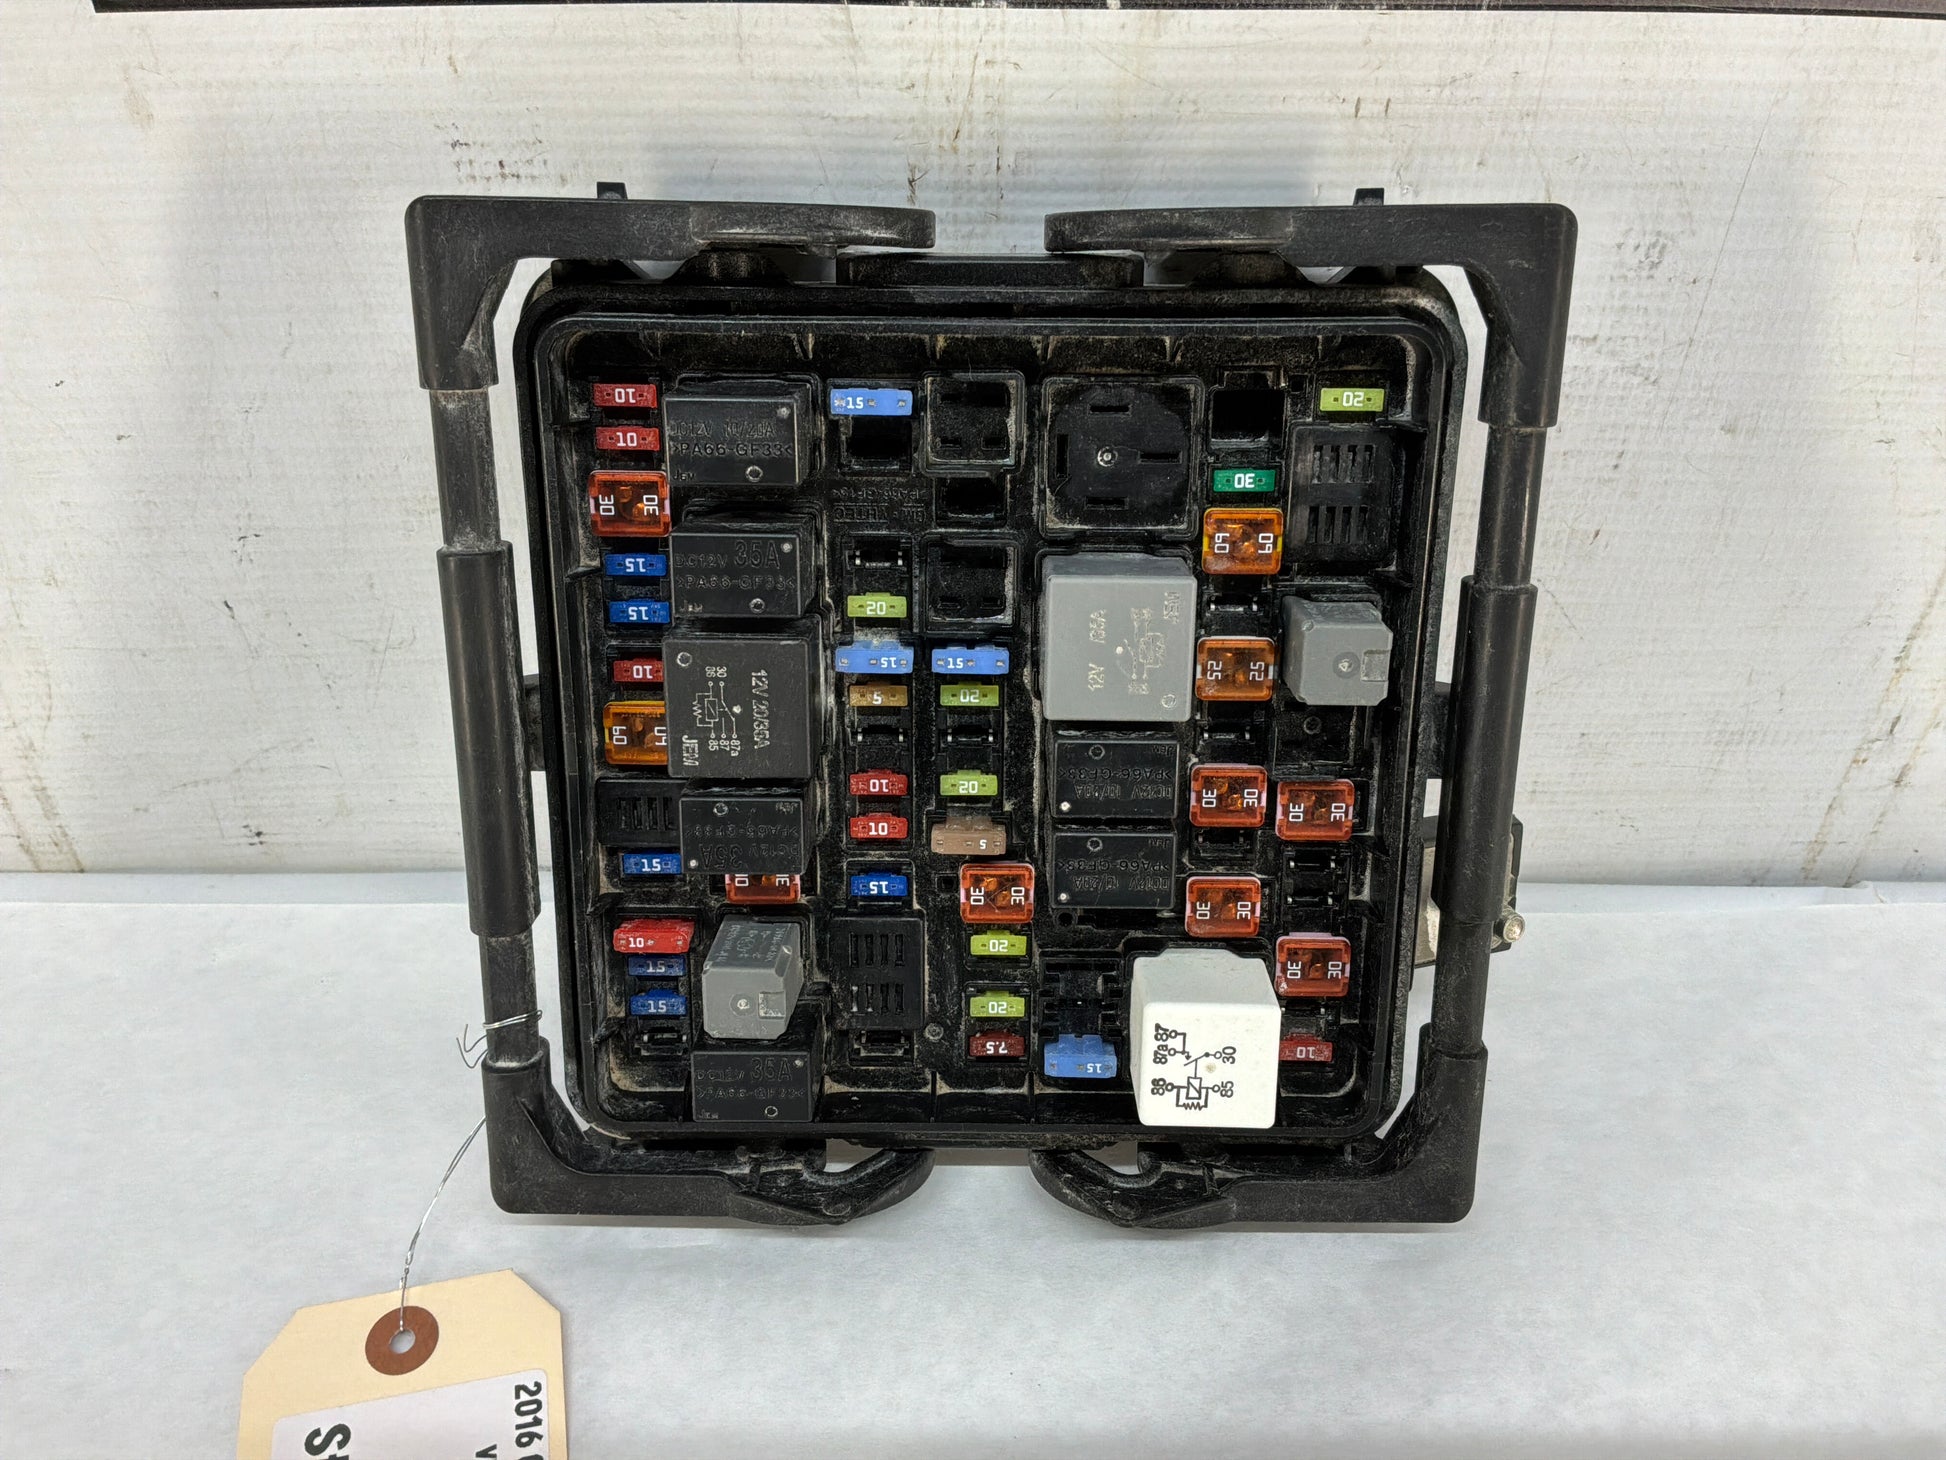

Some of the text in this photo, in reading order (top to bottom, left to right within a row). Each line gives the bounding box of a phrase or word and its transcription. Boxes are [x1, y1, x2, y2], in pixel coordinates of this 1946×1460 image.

[614, 388, 636, 403] 10
[846, 397, 864, 409] 15
[1342, 392, 1364, 406] 20
[617, 432, 637, 447] 10
[1234, 473, 1255, 488] 30
[598, 494, 615, 516] 30
[642, 494, 659, 516] 30
[1214, 532, 1229, 554] 60
[1258, 532, 1273, 554] 60
[734, 540, 780, 569] 35A
[625, 558, 647, 572] 15
[629, 606, 648, 620] 15
[866, 602, 886, 615] 20
[880, 657, 897, 668] 15
[947, 658, 963, 668] 15
[1207, 660, 1223, 680] 25
[1249, 661, 1265, 681] 25
[633, 665, 652, 679] 10
[873, 692, 882, 704] 5
[959, 690, 979, 702] 20
[751, 669, 771, 750] 12V 20/35A
[612, 726, 627, 745] 60
[681, 734, 699, 766] JEM
[870, 779, 888, 792] 10
[959, 781, 978, 794] 20
[1202, 788, 1217, 807] 30
[1243, 788, 1258, 807] 30
[1289, 803, 1303, 822] 30
[1331, 803, 1346, 822] 30
[869, 822, 888, 835] 10
[979, 840, 987, 849] 5
[641, 858, 661, 872] 15
[699, 844, 743, 869] 35A
[869, 881, 888, 893] 15
[970, 887, 984, 905] 30
[1011, 887, 1024, 905] 30
[1196, 901, 1210, 920] 30
[1237, 901, 1251, 919] 30
[628, 937, 644, 948] 10
[989, 940, 1008, 952] 20
[646, 961, 665, 973] 15
[1287, 960, 1302, 979] 30
[1328, 960, 1342, 979] 30
[648, 1000, 667, 1012] 15
[988, 1002, 1007, 1013] 20
[1154, 1023, 1169, 1042] 87
[986, 1042, 1007, 1054] 7.5
[1153, 1044, 1168, 1065] 87a
[1222, 1046, 1236, 1065] 30
[1295, 1047, 1314, 1059] 10
[751, 1057, 792, 1082] 35A
[1087, 1063, 1101, 1073] 15
[1151, 1077, 1165, 1095] 86
[1220, 1081, 1234, 1098] 85
[514, 1381, 543, 1449] 2016
[304, 1424, 351, 1460] S
